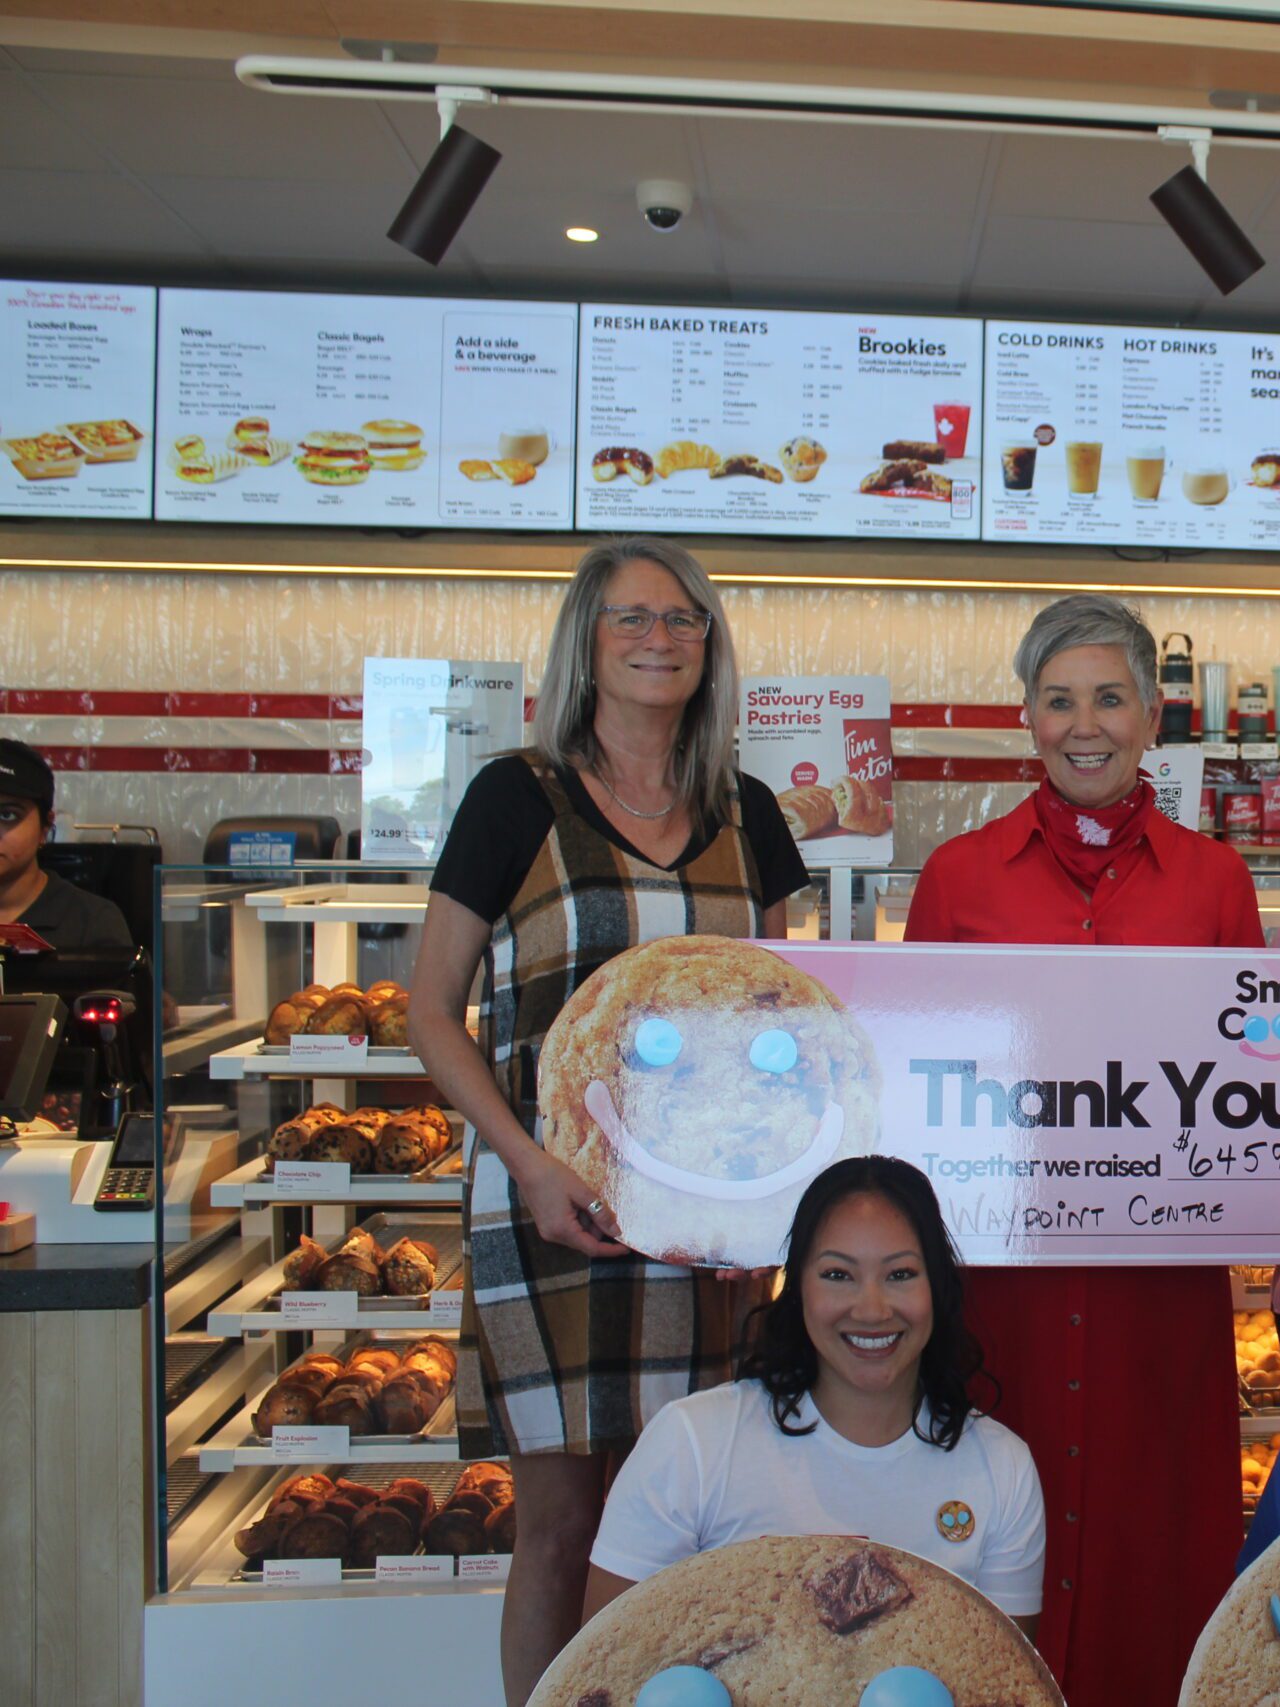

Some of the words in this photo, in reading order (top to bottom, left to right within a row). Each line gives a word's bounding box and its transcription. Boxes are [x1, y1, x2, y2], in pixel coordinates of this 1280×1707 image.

[180, 326, 213, 338] Wraps
[593, 315, 645, 331] FRESH
[649, 317, 705, 333] BAKED
[709, 319, 768, 335] TREATS
[317, 330, 351, 343] Classic
[352, 331, 386, 345] Bagels
[455, 335, 482, 349] Add
[483, 339, 492, 349] a
[494, 337, 520, 350] side
[859, 335, 947, 356] Brookies
[998, 332, 1043, 348] COLD
[1047, 335, 1104, 350] DRINKS
[1123, 338, 1157, 352] HOT
[1161, 340, 1218, 355] DRINKS
[1250, 345, 1275, 361] It's
[454, 349, 465, 361] &
[467, 351, 476, 361] a
[478, 350, 537, 364] beverage
[373, 671, 426, 690] Spring
[430, 672, 515, 691] Drinkware
[758, 686, 783, 695] NEW
[747, 690, 825, 709] Savoury
[829, 690, 865, 709] Egg
[747, 710, 823, 726] Pastries
[1230, 796, 1250, 810] Tim
[909, 1058, 1152, 1129] Thank
[921, 1152, 1041, 1184] Together
[1044, 1160, 1081, 1178] we
[1084, 1153, 1162, 1178] raised
[1128, 1194, 1225, 1227] CENTRE
